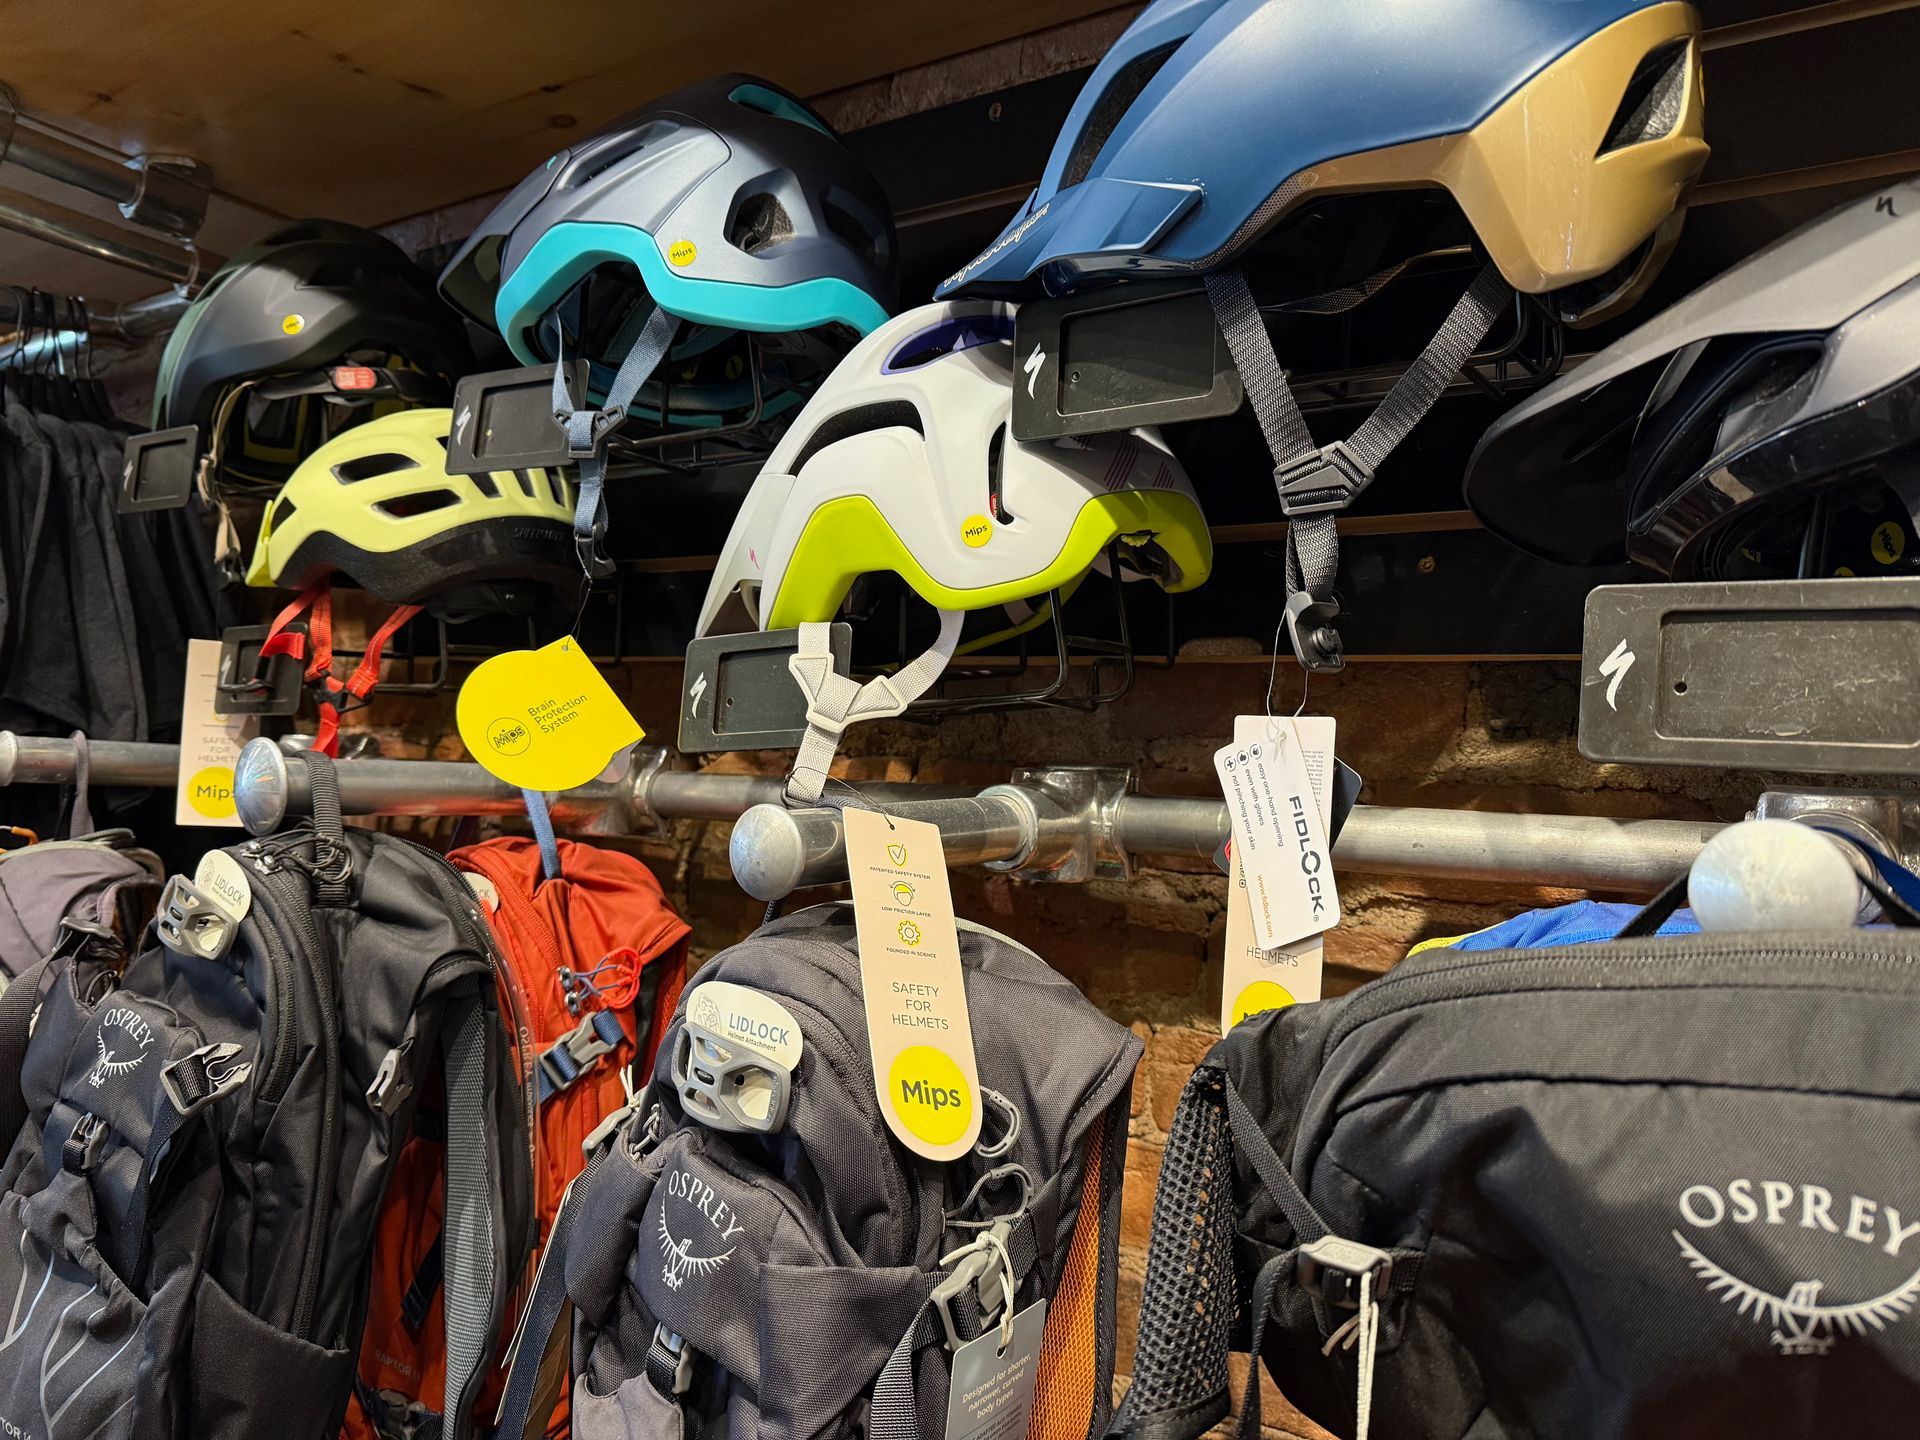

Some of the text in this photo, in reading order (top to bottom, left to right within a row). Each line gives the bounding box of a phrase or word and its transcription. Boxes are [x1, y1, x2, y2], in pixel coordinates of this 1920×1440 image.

[672, 247, 693, 259] Mips
[964, 524, 988, 538] Mips
[1878, 527, 1897, 558] Mips
[527, 698, 557, 717] Brain
[534, 694, 588, 725] Protection
[540, 710, 579, 733] System
[493, 725, 526, 749] Mips
[209, 746, 231, 754] FOR
[196, 785, 235, 801] Mip
[1244, 768, 1265, 827] even with gloves
[1231, 774, 1256, 850] not pinching your skin
[1257, 763, 1284, 848] easy one-hand opening
[869, 866, 894, 874] PATENTED
[214, 873, 245, 905] LIDLOCK
[893, 907, 916, 915] FRICTION
[1257, 873, 1274, 938] www.fidlock.com
[886, 947, 910, 955] FOUNDED
[916, 951, 937, 959] SCIENCE
[1246, 945, 1299, 968] HELMETS
[892, 981, 940, 997] SAFETY
[905, 999, 932, 1013] FOR
[103, 1008, 154, 1050] OSPREY
[729, 1012, 790, 1046] LIDLOCK
[892, 1013, 949, 1030] HELMETS
[727, 1031, 777, 1052] Helmet Attachment
[901, 1079, 962, 1111] Mips
[668, 1170, 745, 1241] OSPREY
[1679, 1178, 1920, 1257] OSPREY
[962, 1375, 996, 1404] Designed
[996, 1369, 1007, 1383] for
[1002, 1368, 1024, 1390] curved
[976, 1389, 1014, 1419] body types
